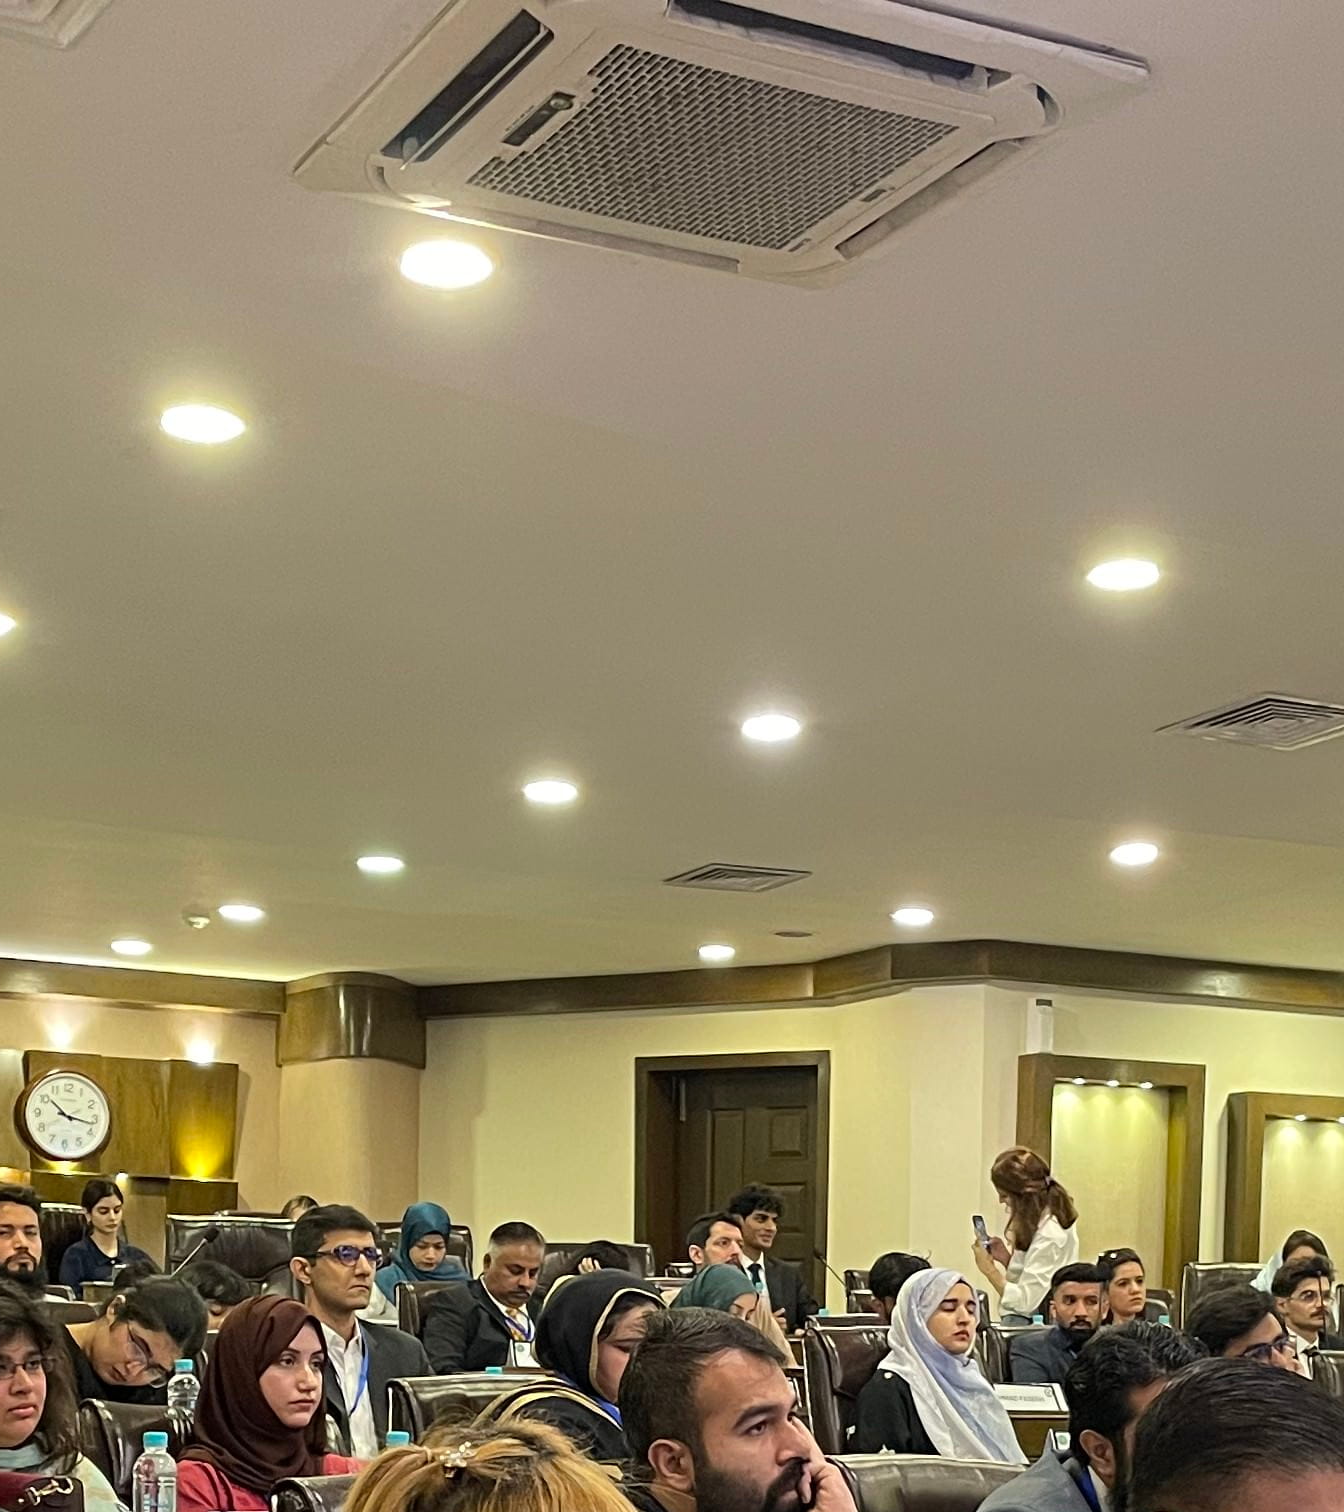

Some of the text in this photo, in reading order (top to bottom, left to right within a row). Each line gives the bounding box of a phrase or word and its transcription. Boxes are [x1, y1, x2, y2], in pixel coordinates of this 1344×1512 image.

[51, 1085, 59, 1095] 11
[64, 1083, 74, 1093] 12
[40, 1094, 50, 1104] 10
[87, 1099, 96, 1109] 2
[34, 1107, 41, 1118] 9
[38, 1122, 46, 1132] 8
[86, 1128, 93, 1136] 4
[49, 1134, 56, 1143] 7
[75, 1137, 82, 1146] 5
